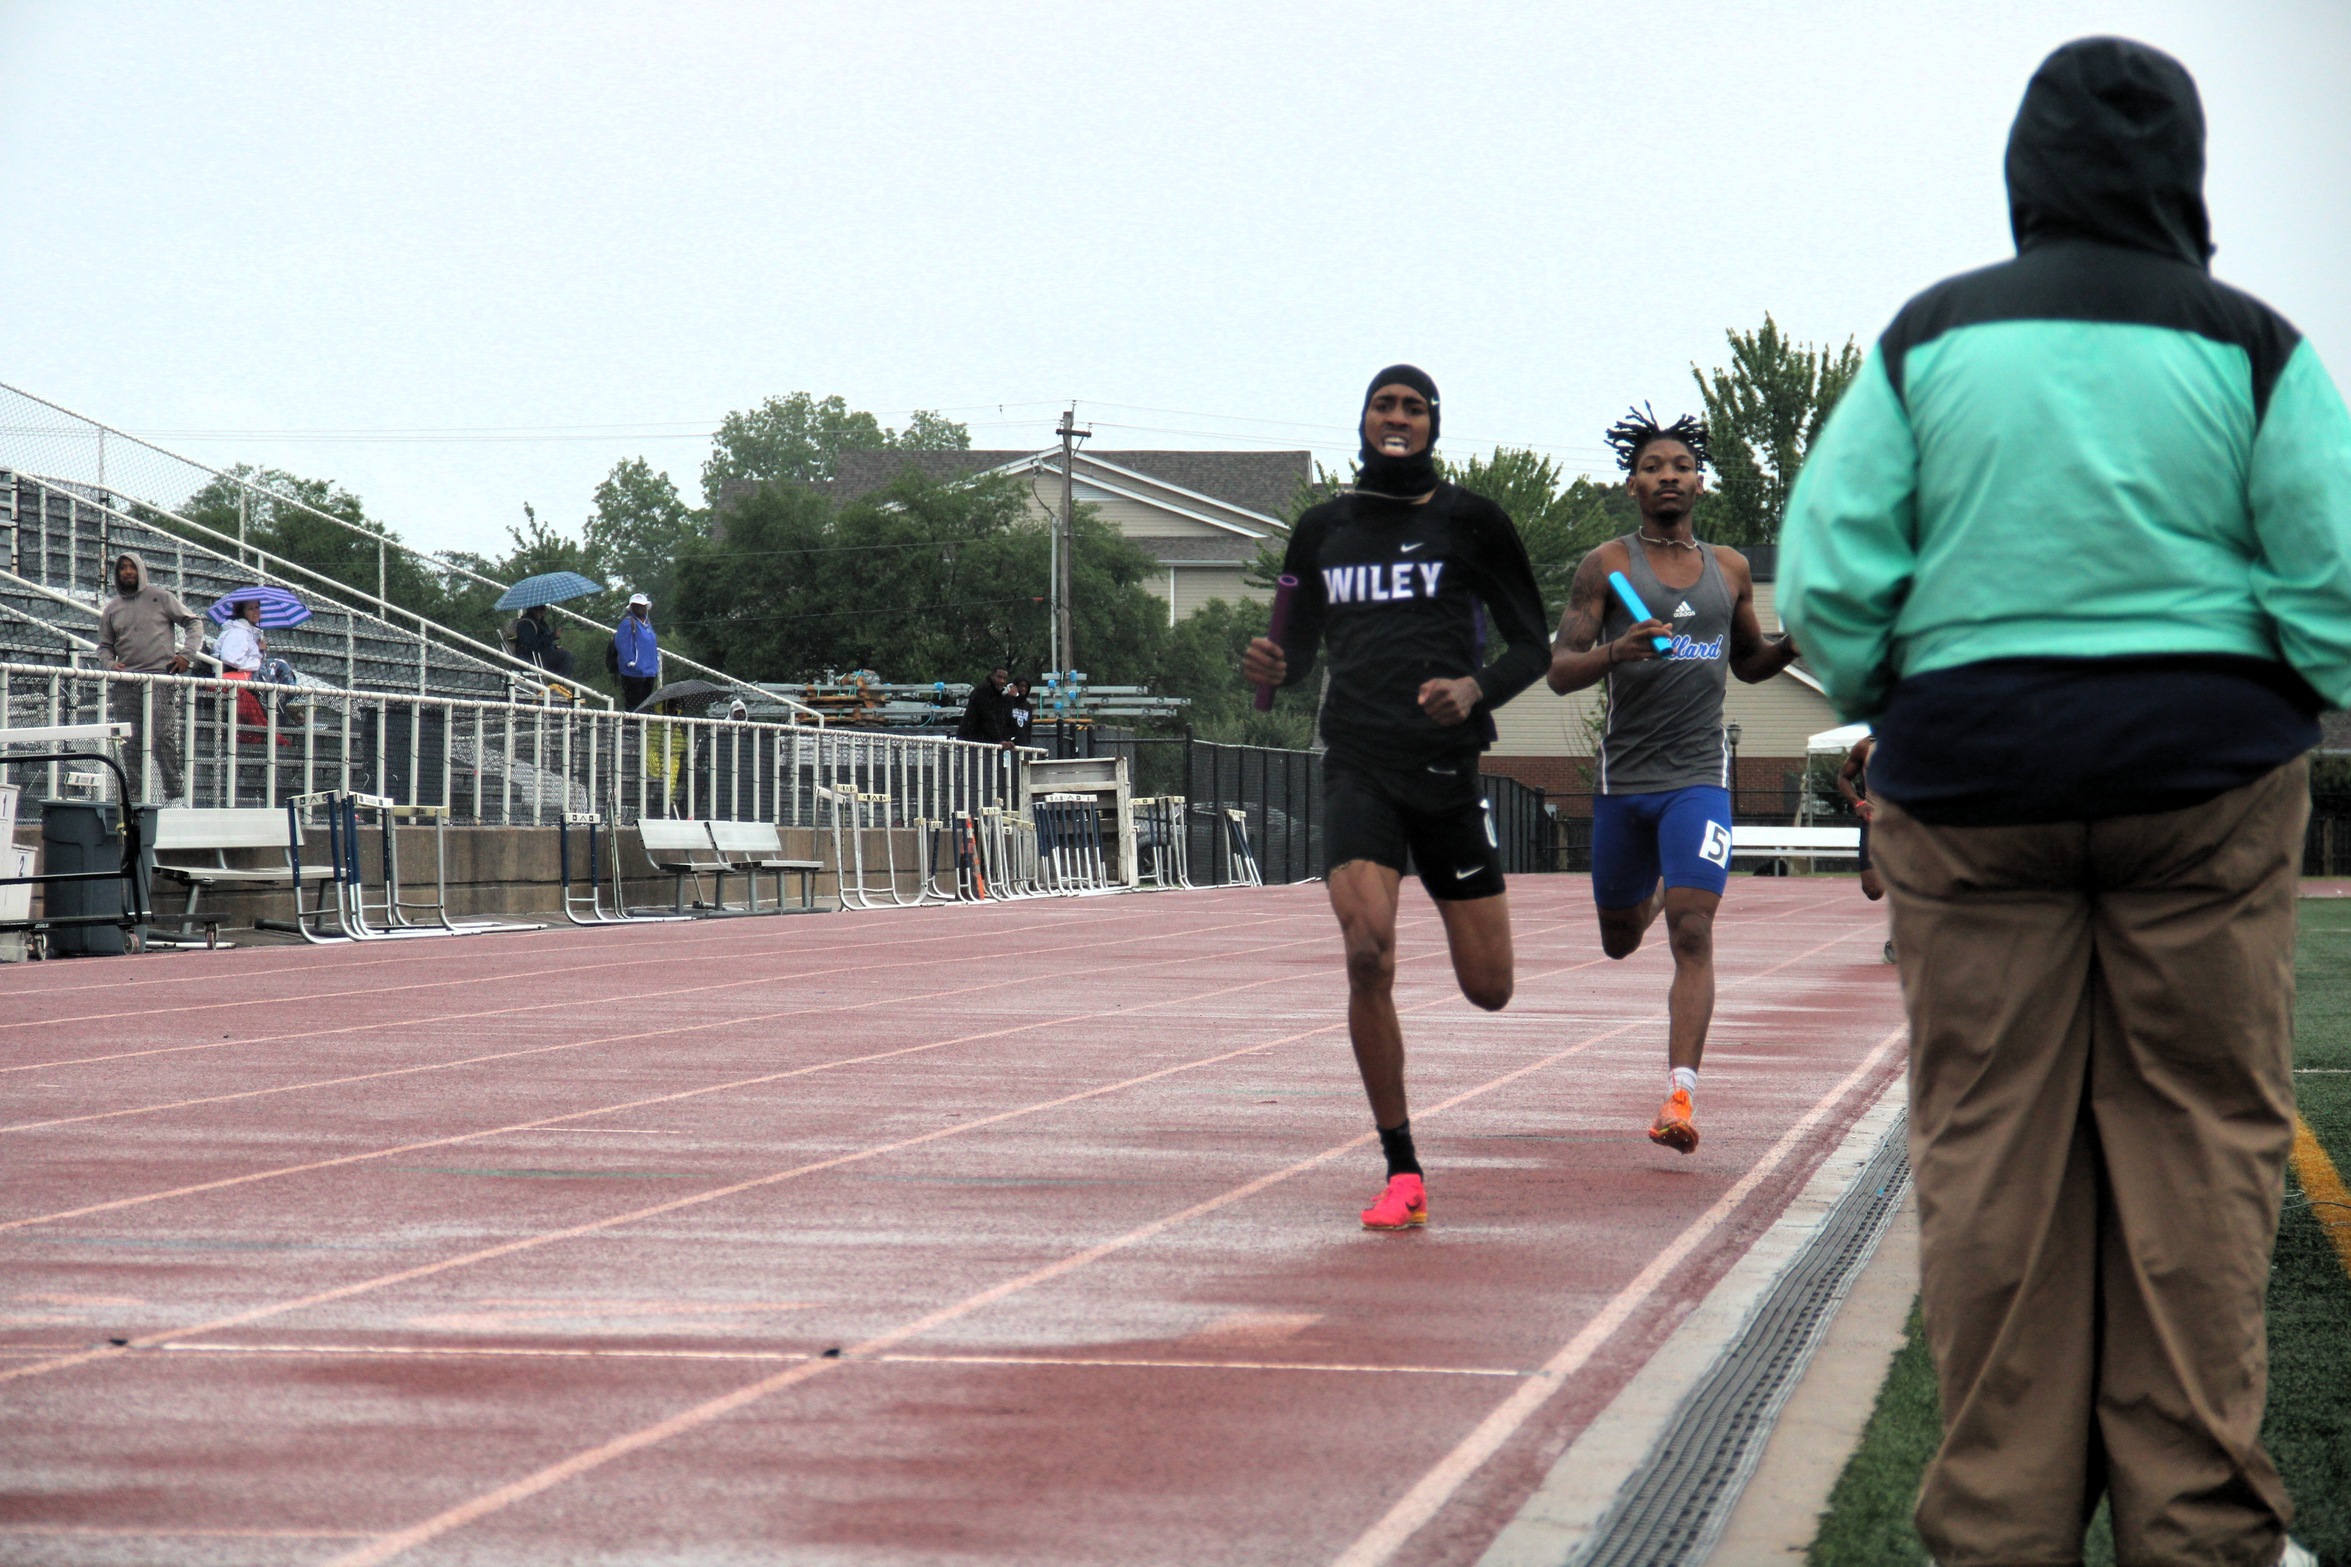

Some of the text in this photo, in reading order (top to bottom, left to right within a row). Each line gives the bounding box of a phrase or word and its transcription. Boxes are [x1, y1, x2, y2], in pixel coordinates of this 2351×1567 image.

[1322, 562, 1444, 604] WILEY
[1673, 610, 1696, 618] adidas
[1667, 634, 1724, 660] llard
[1707, 825, 1727, 861] 5
[18, 854, 25, 878] 2
